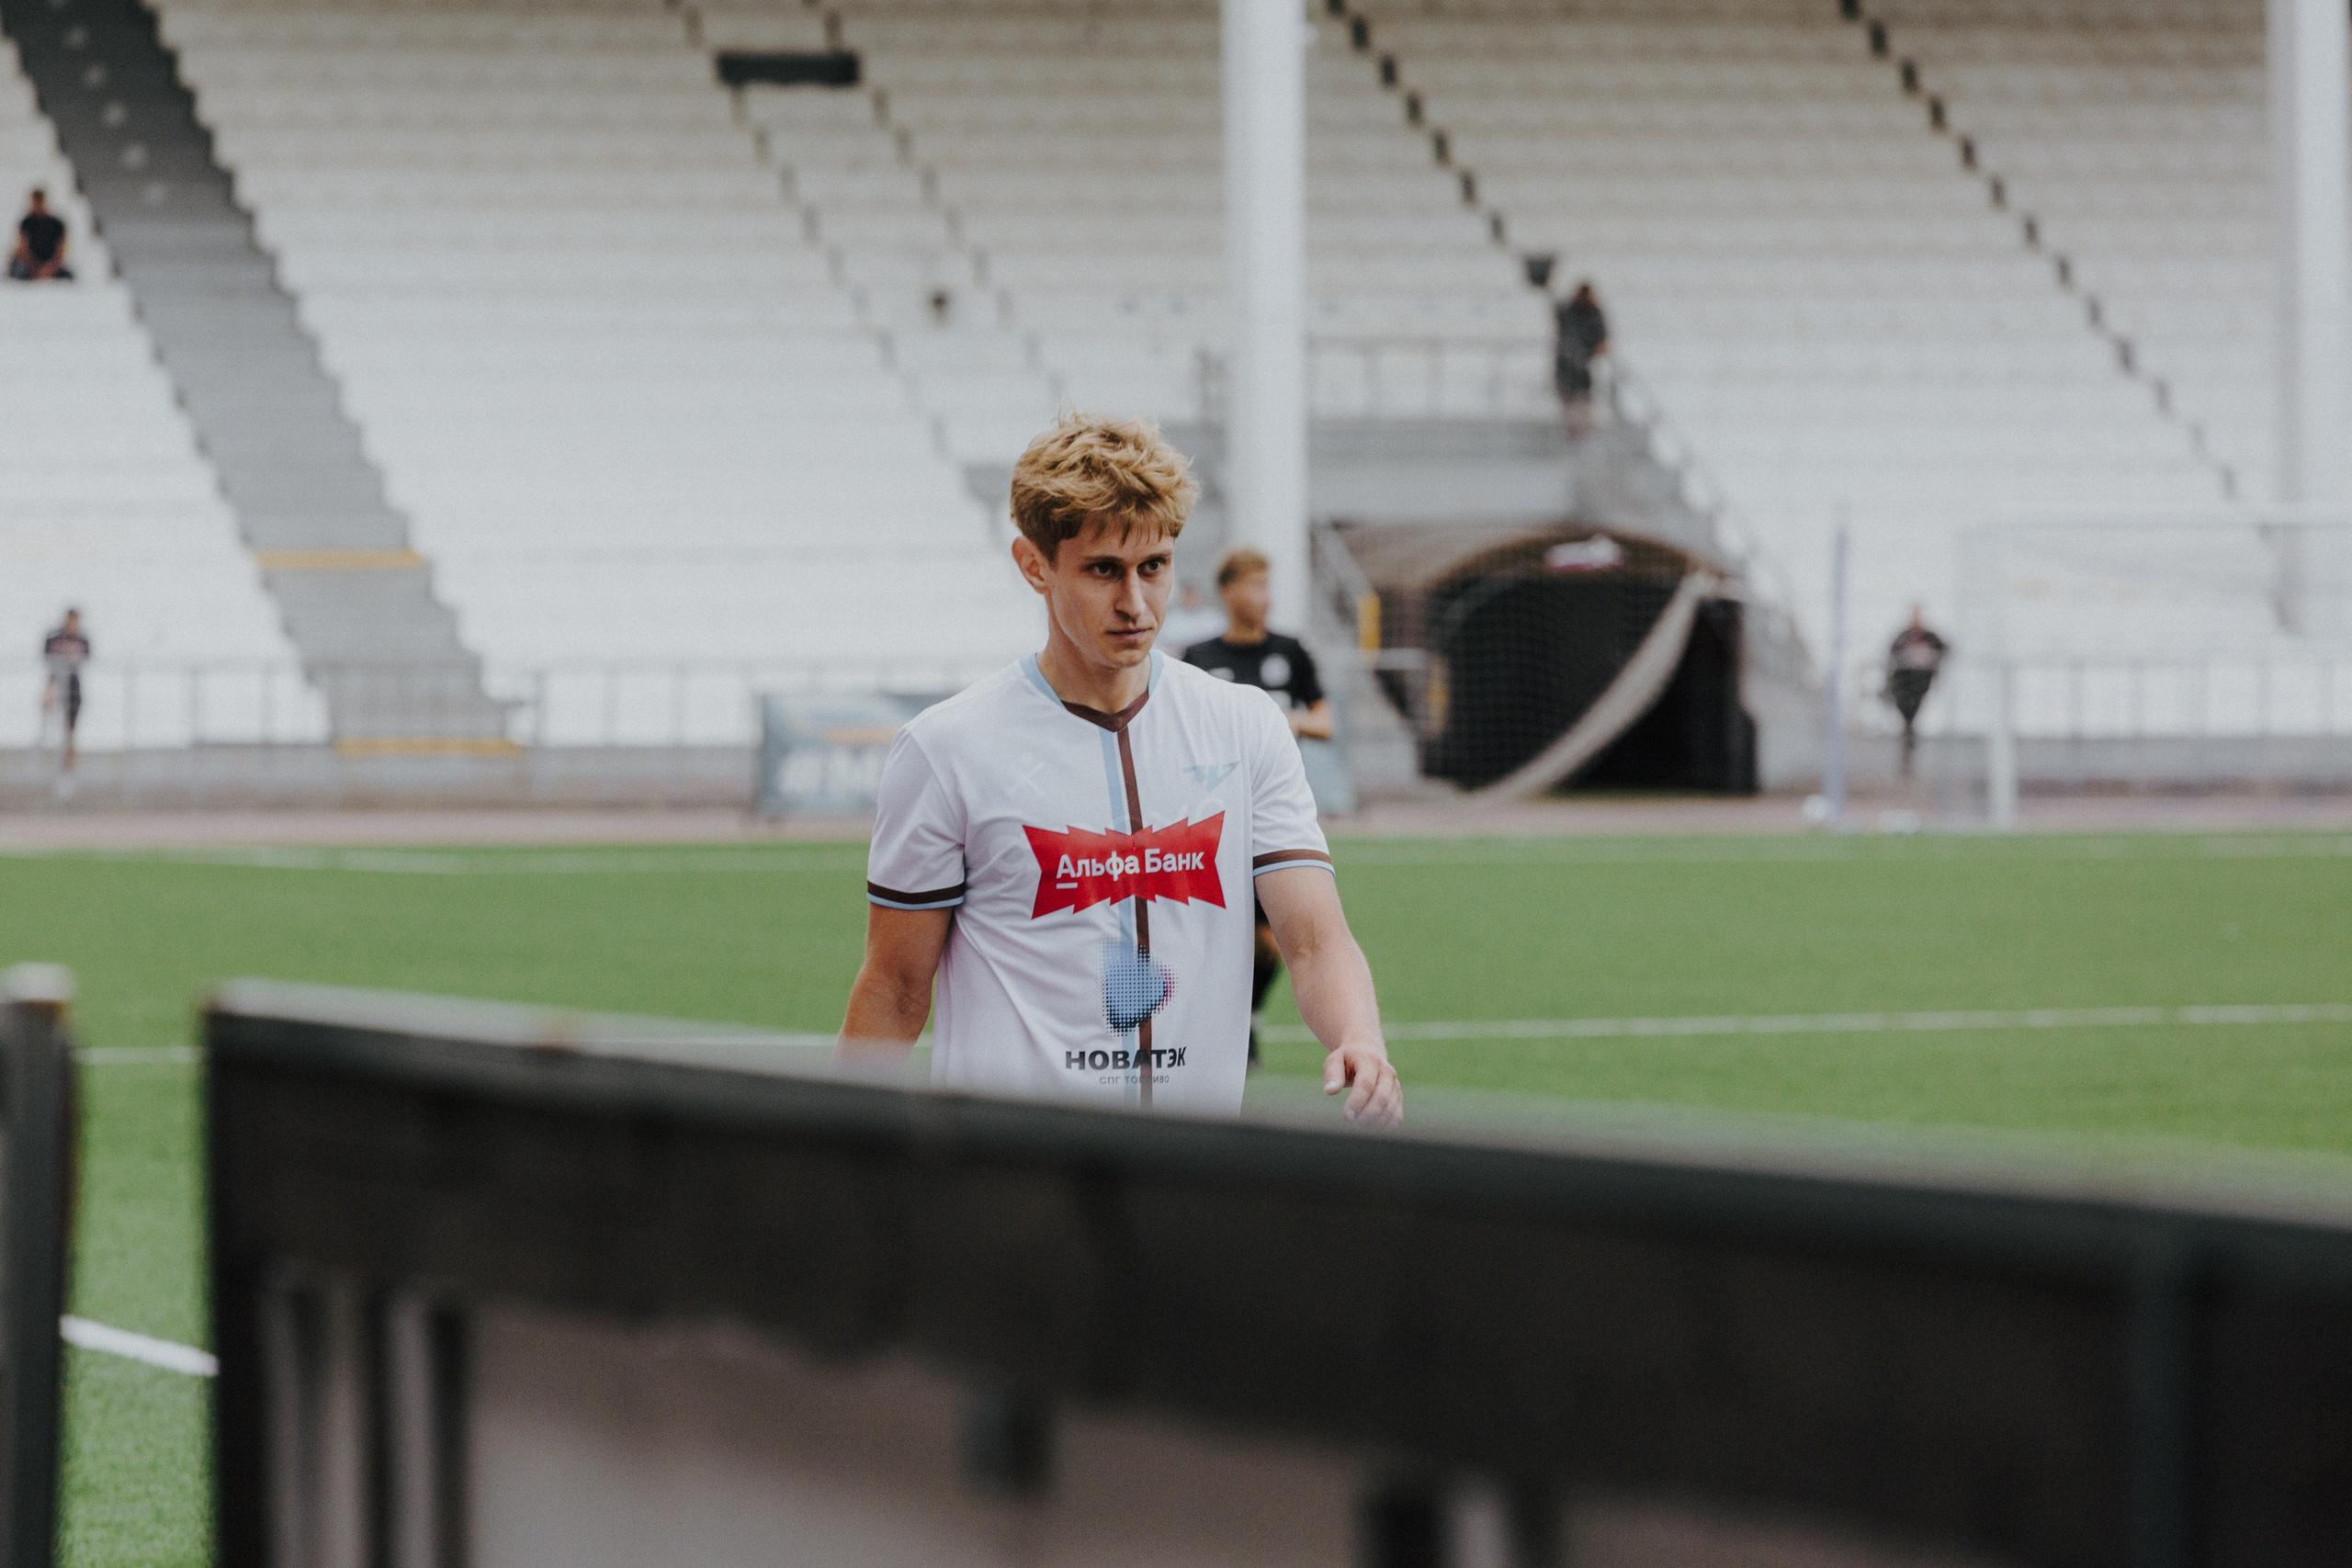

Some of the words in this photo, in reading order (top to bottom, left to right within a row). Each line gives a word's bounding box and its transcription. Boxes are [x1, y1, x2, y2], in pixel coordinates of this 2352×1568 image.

[1056, 850, 1140, 884] Альфа
[1145, 848, 1205, 874] Банк
[1065, 1045, 1187, 1070] НОВАТЭК
[1099, 1076, 1120, 1085] СПГ
[1125, 1075, 1170, 1085] ТОИВО
